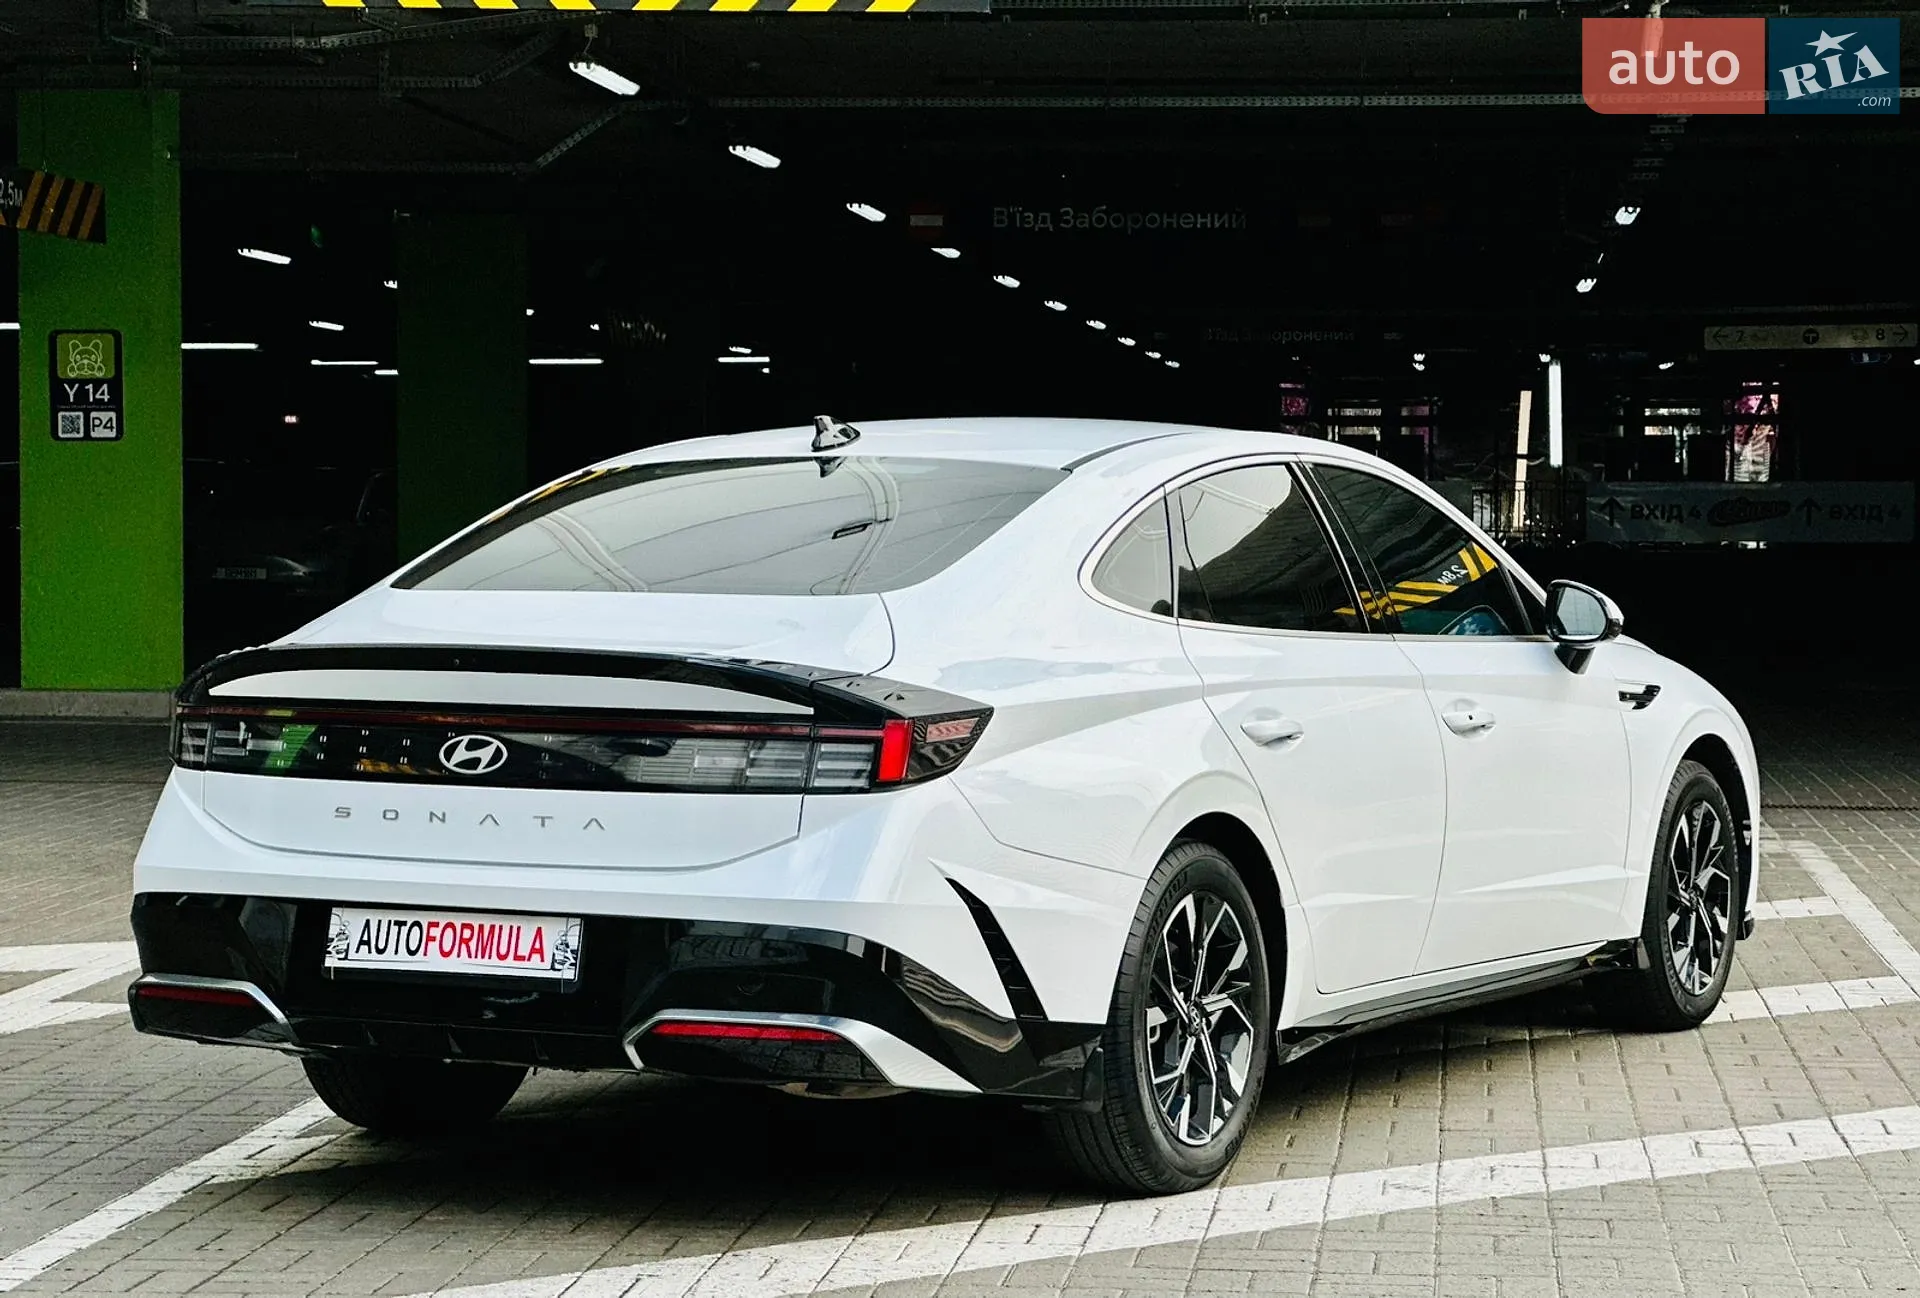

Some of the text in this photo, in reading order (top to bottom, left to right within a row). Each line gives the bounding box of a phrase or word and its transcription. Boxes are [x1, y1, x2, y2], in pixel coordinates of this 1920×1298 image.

[1059, 204, 1249, 236] Заборонений
[1876, 328, 1886, 341] 8
[63, 383, 111, 403] Y 14
[91, 416, 115, 433] P4
[334, 806, 606, 831] SONATA
[355, 918, 546, 963] AUTOFORMULA
